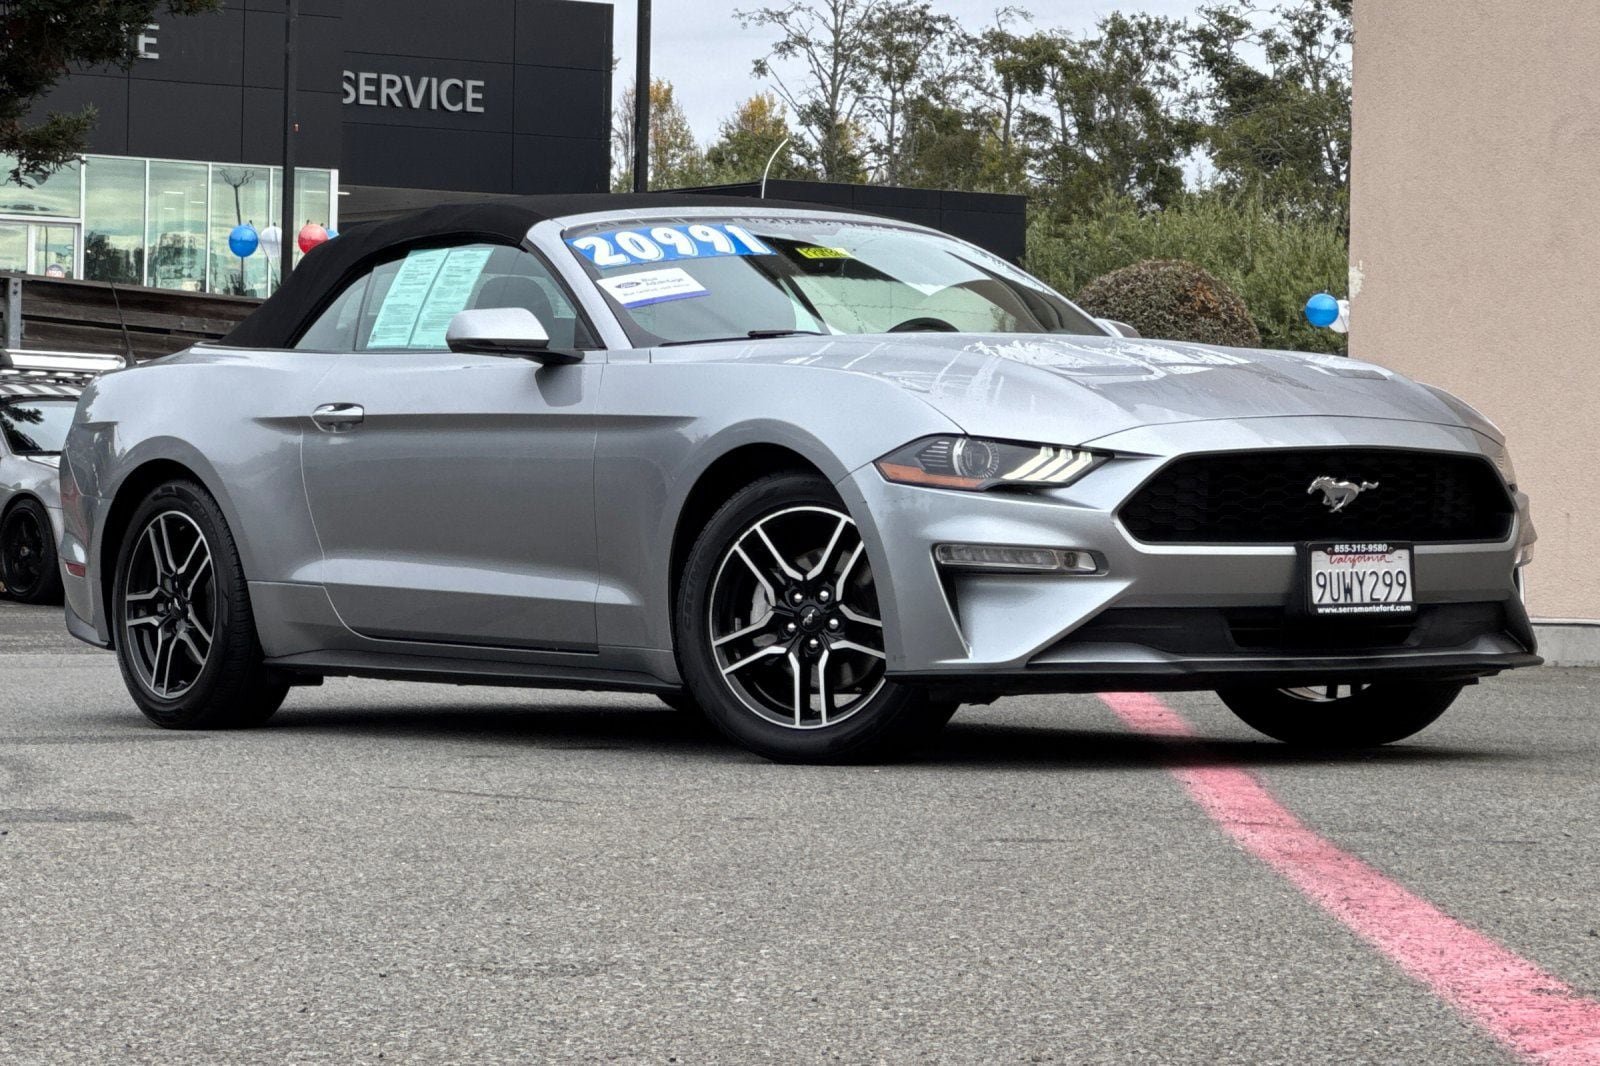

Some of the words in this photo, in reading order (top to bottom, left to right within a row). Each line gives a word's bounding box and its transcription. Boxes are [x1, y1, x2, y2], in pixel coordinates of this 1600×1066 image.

[342, 70, 485, 113] SERVICE
[573, 224, 772, 266] 20991
[1334, 544, 1388, 553] 855-315-9580
[1328, 554, 1393, 567] California
[1315, 570, 1407, 602] 9UWY299
[1317, 605, 1412, 614] www.serramonteford.com
